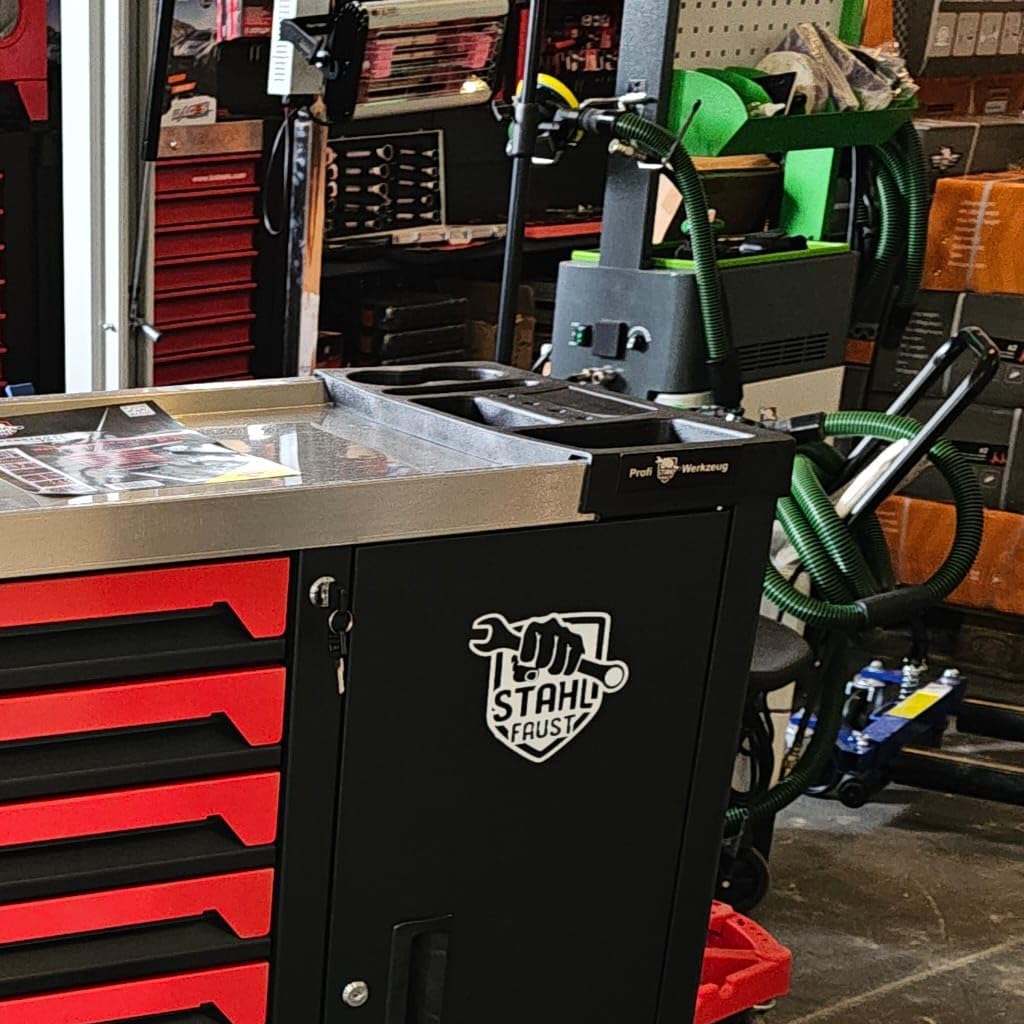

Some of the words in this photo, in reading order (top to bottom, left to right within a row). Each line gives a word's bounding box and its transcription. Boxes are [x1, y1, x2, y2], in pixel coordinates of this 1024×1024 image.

[629, 467, 653, 478] Profi
[681, 462, 729, 473] Werkzeug
[493, 678, 593, 722] STAHL
[511, 714, 576, 743] FAUST
